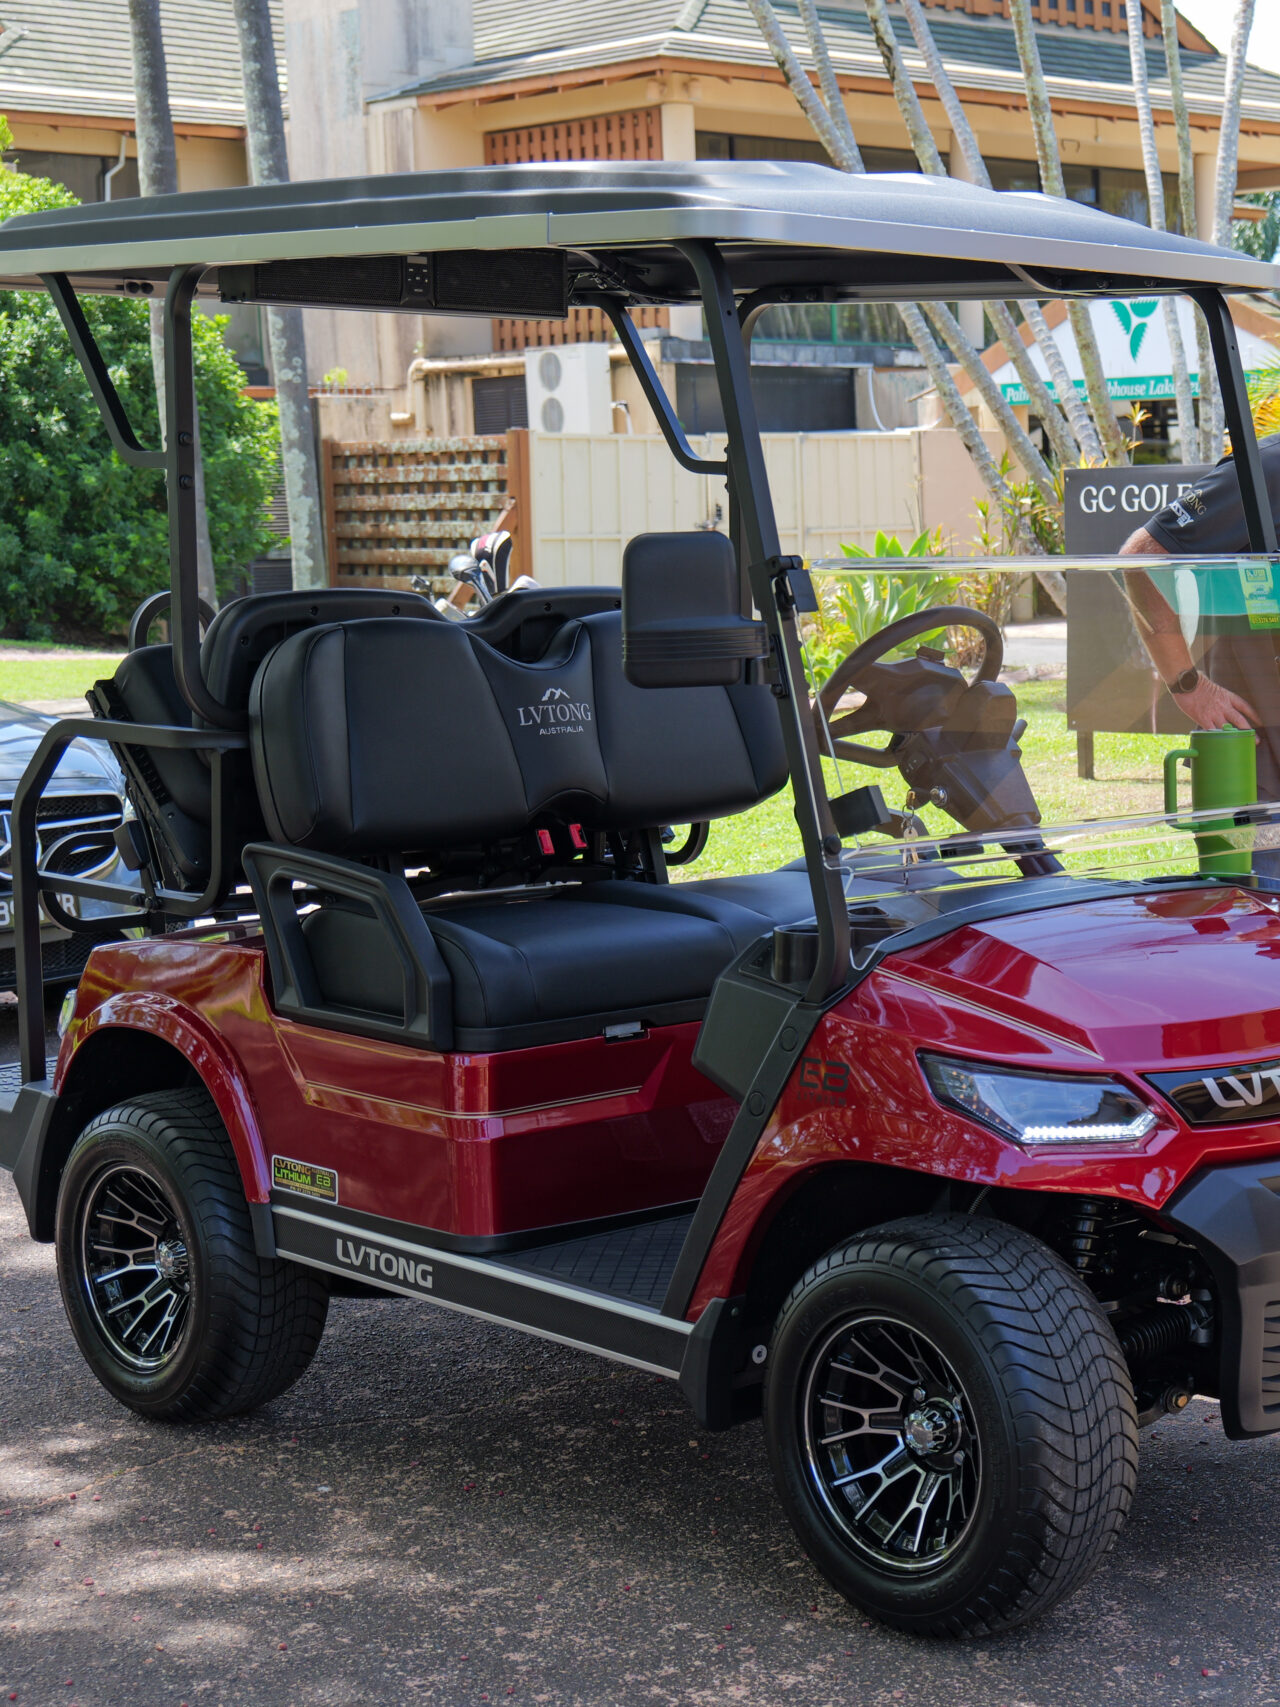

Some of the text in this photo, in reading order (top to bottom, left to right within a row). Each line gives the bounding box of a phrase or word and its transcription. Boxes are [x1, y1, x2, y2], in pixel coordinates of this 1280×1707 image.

[1080, 485, 1116, 513] GC
[517, 703, 591, 726] LVTONG
[540, 726, 584, 735] AUSTRALIA
[275, 1158, 311, 1175] LVTONG
[275, 1167, 311, 1185] LITHIUM
[336, 1238, 433, 1289] LVTONG
